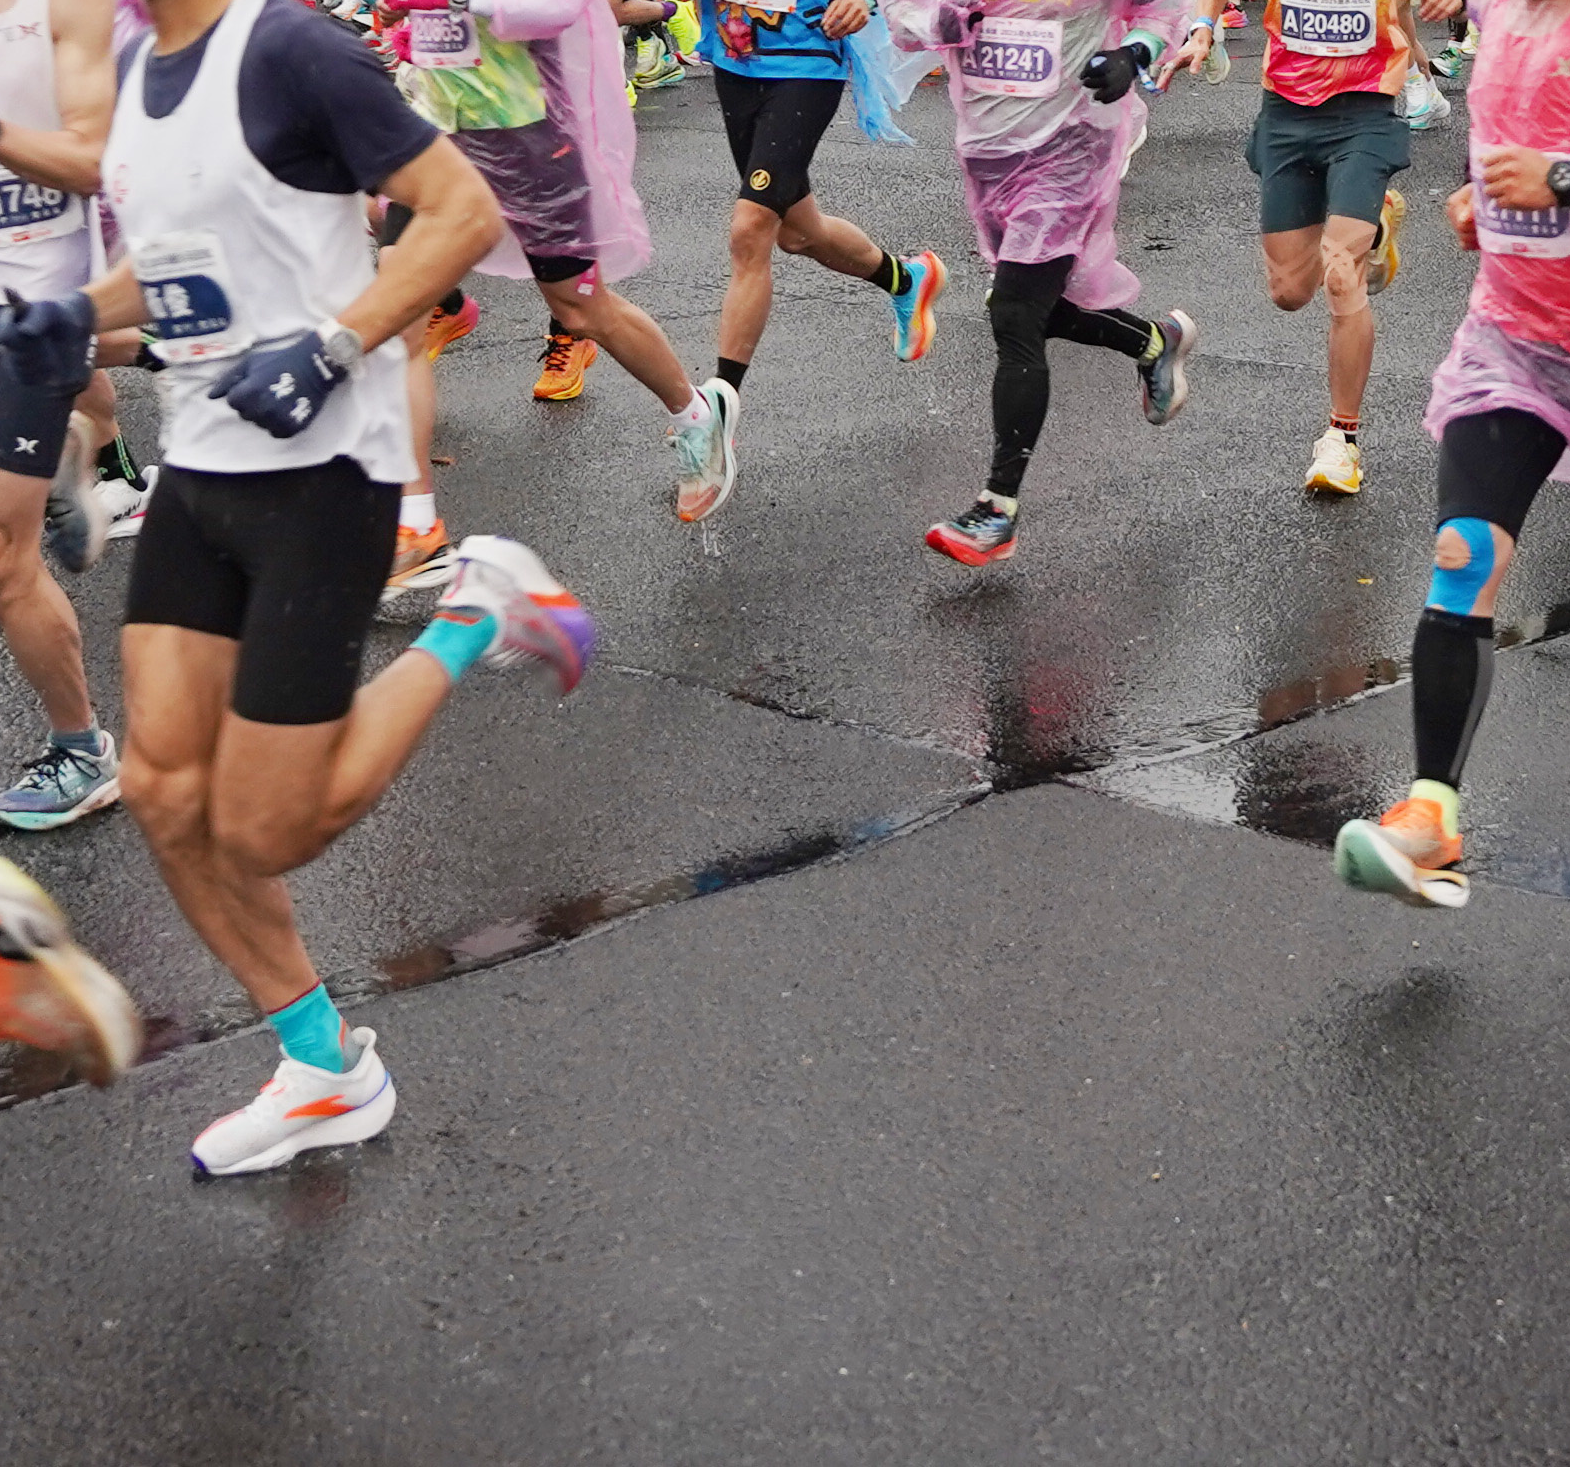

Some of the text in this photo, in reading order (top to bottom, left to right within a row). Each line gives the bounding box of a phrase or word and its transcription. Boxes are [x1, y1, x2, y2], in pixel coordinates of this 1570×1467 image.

[1283, 9, 1366, 34] A 20480
[981, 46, 1045, 72] 21241
